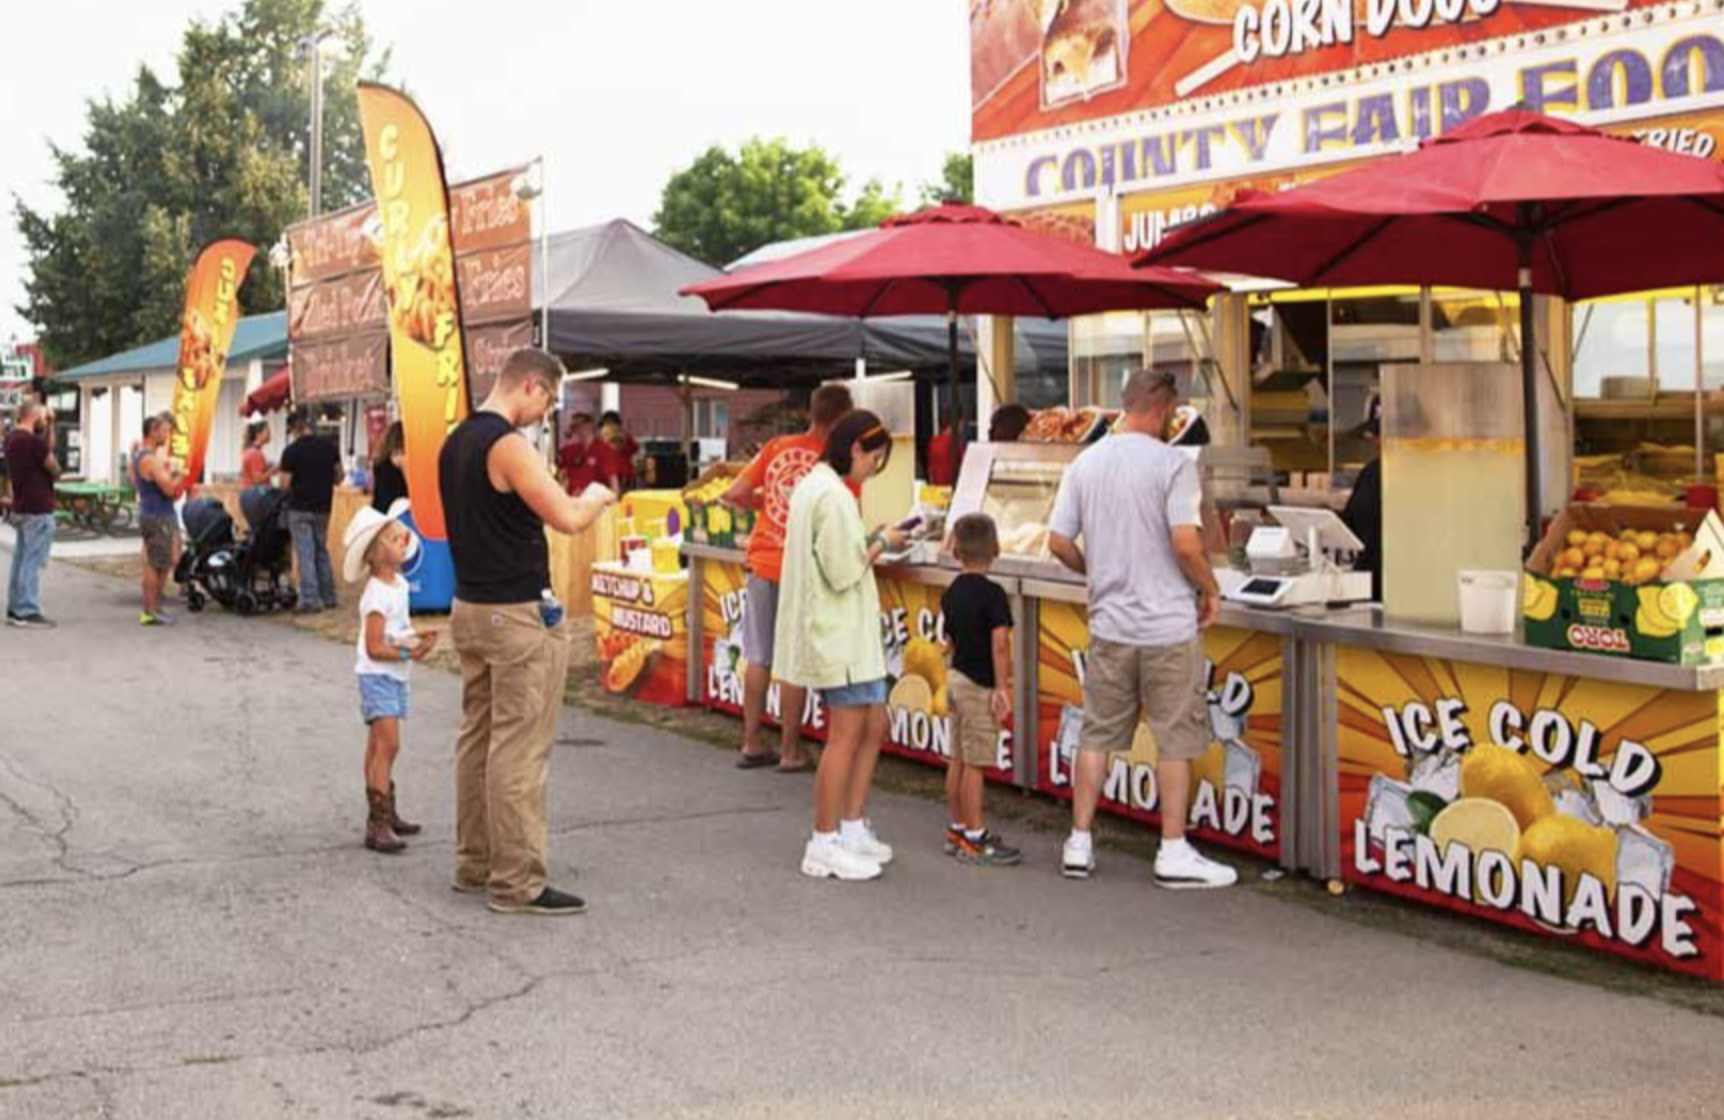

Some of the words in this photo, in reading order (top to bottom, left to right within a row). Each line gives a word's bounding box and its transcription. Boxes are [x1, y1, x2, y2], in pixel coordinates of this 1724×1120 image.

[1233, 0, 1352, 63] CORN
[1632, 127, 1714, 158] RIED
[1124, 203, 1217, 252] JUM
[435, 312, 459, 436] FRI
[612, 604, 672, 638] MUSTARD
[1382, 698, 1470, 756] ICE
[1488, 701, 1660, 794] COLD
[1354, 818, 1698, 956] LEMONADE
